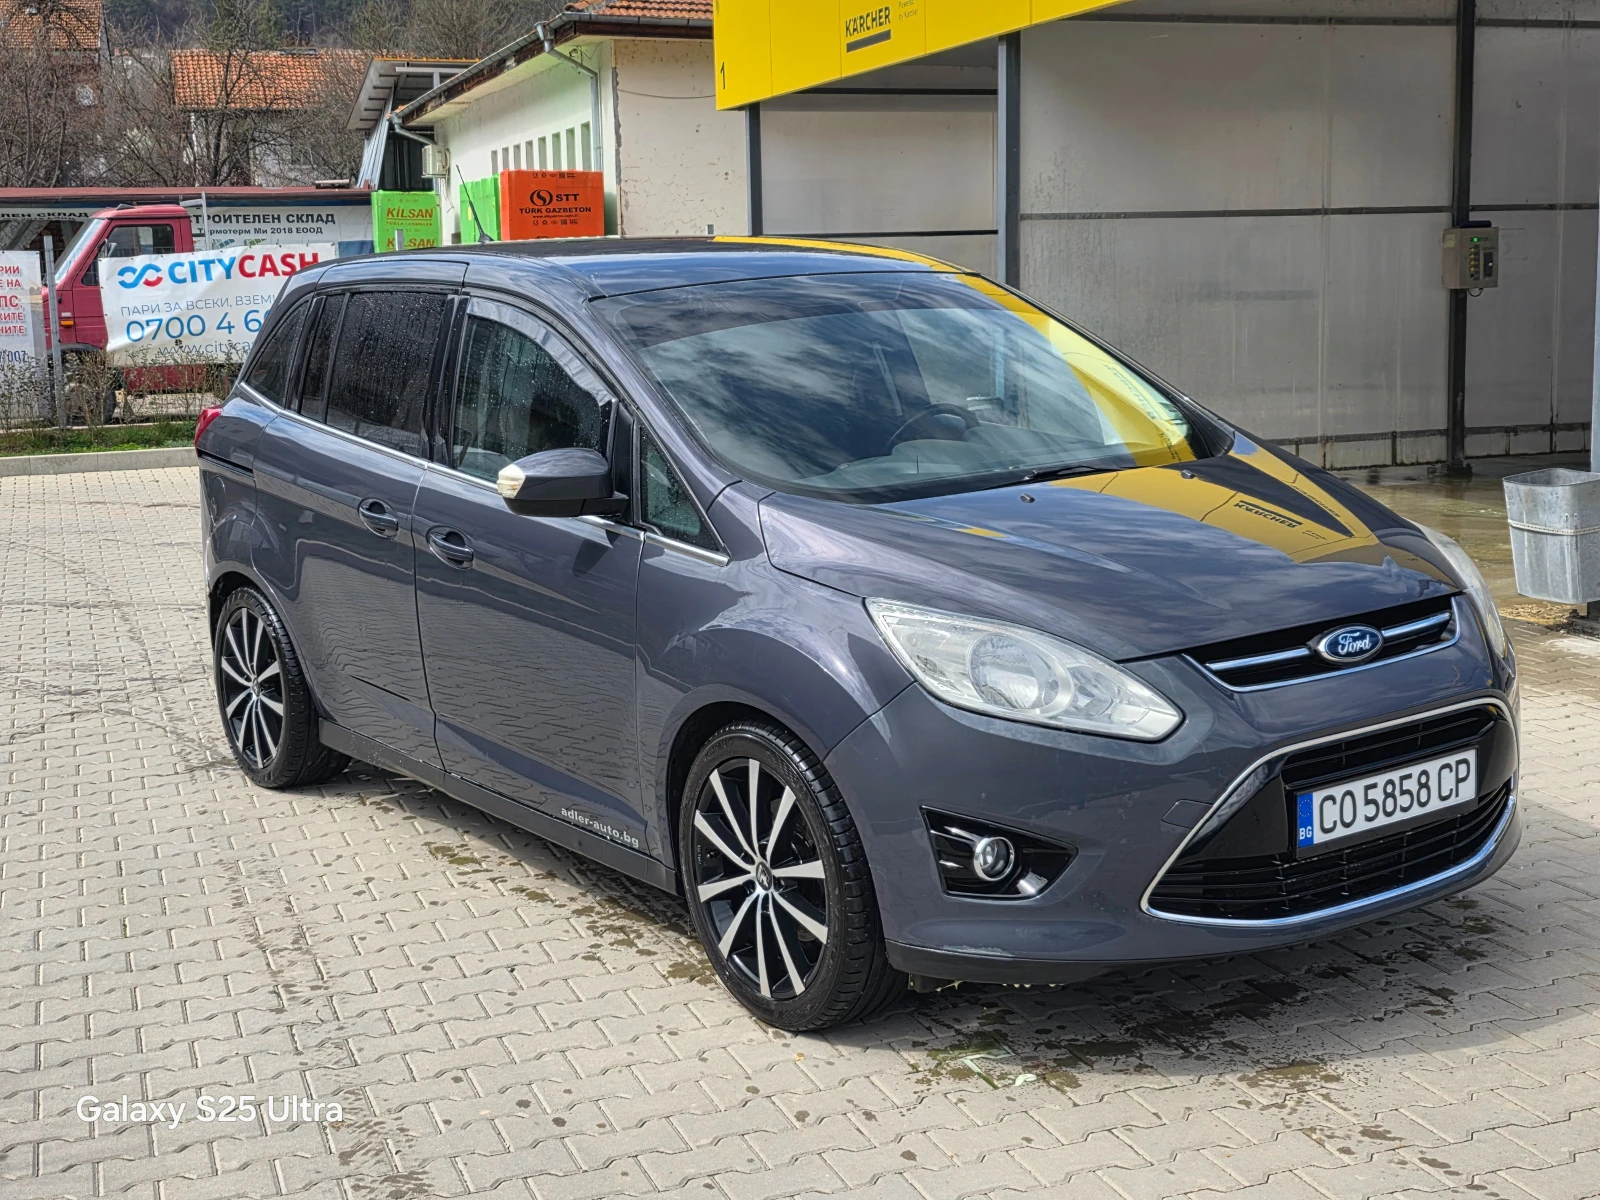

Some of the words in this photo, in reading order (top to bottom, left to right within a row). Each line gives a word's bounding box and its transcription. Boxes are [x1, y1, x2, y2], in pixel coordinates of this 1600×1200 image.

[845, 6, 891, 38] KÄRCHER
[555, 193, 579, 202] STT
[190, 213, 281, 225] ТРОИТЕЛЕН
[286, 213, 336, 225] СКЛАД
[545, 206, 591, 214] GAZBETON
[296, 227, 323, 235] ЕООД
[167, 252, 319, 285] CITYCASH
[6, 278, 21, 288] НА
[120, 304, 161, 317] ПАРИ
[164, 302, 183, 312] ЗА
[186, 298, 232, 311] ВСЕКИ,
[235, 294, 275, 306] ВЗЕМ
[126, 314, 206, 342] 0700
[215, 311, 235, 335] 4
[243, 309, 271, 333] 6
[1338, 631, 1372, 655] Ford
[561, 807, 639, 849] adler-auto.bg
[1299, 825, 1313, 841] BG
